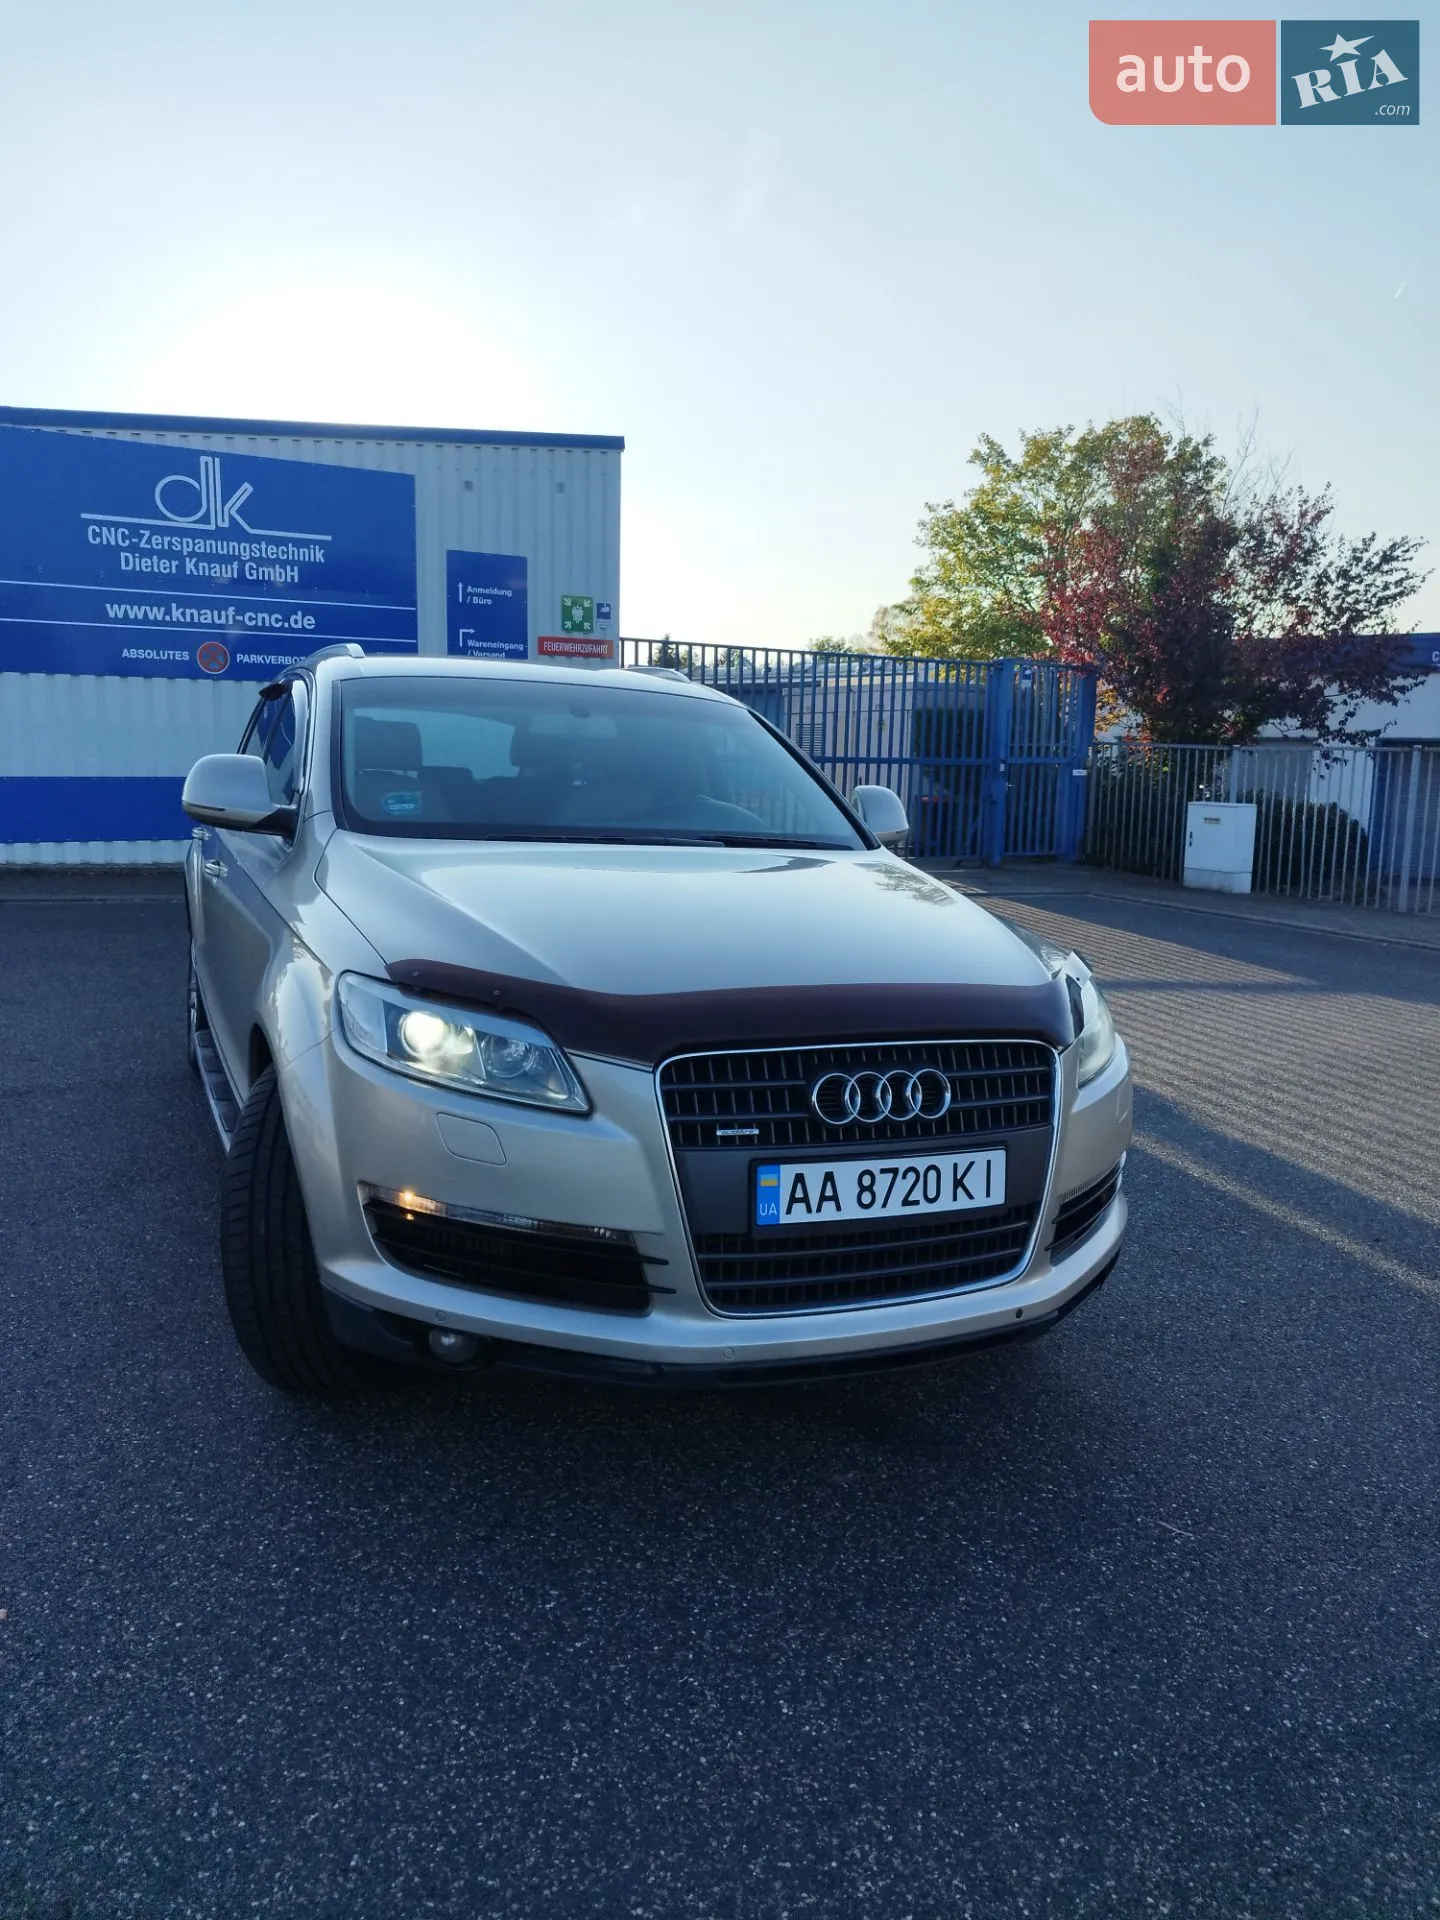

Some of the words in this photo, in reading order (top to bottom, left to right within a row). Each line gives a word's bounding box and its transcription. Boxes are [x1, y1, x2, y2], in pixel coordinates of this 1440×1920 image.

[87, 525, 325, 563] CNC-Zerspanungstechnik
[119, 551, 179, 575] Dieter
[184, 557, 239, 580] Knauf
[244, 561, 299, 584] GmbH
[466, 585, 512, 597] Anmeldung
[472, 596, 493, 606] Büro
[105, 603, 316, 630] www.knauf-cnc.de
[466, 639, 524, 652] Wareneingang
[543, 641, 609, 654] FEUERWEHRZUFAHRT
[121, 648, 190, 661] ABSOLUTES
[236, 654, 305, 665] PARKVERBO
[785, 1170, 842, 1216] AA
[856, 1165, 942, 1210] 8720
[951, 1158, 993, 1203] KI
[759, 1203, 778, 1217] UA
